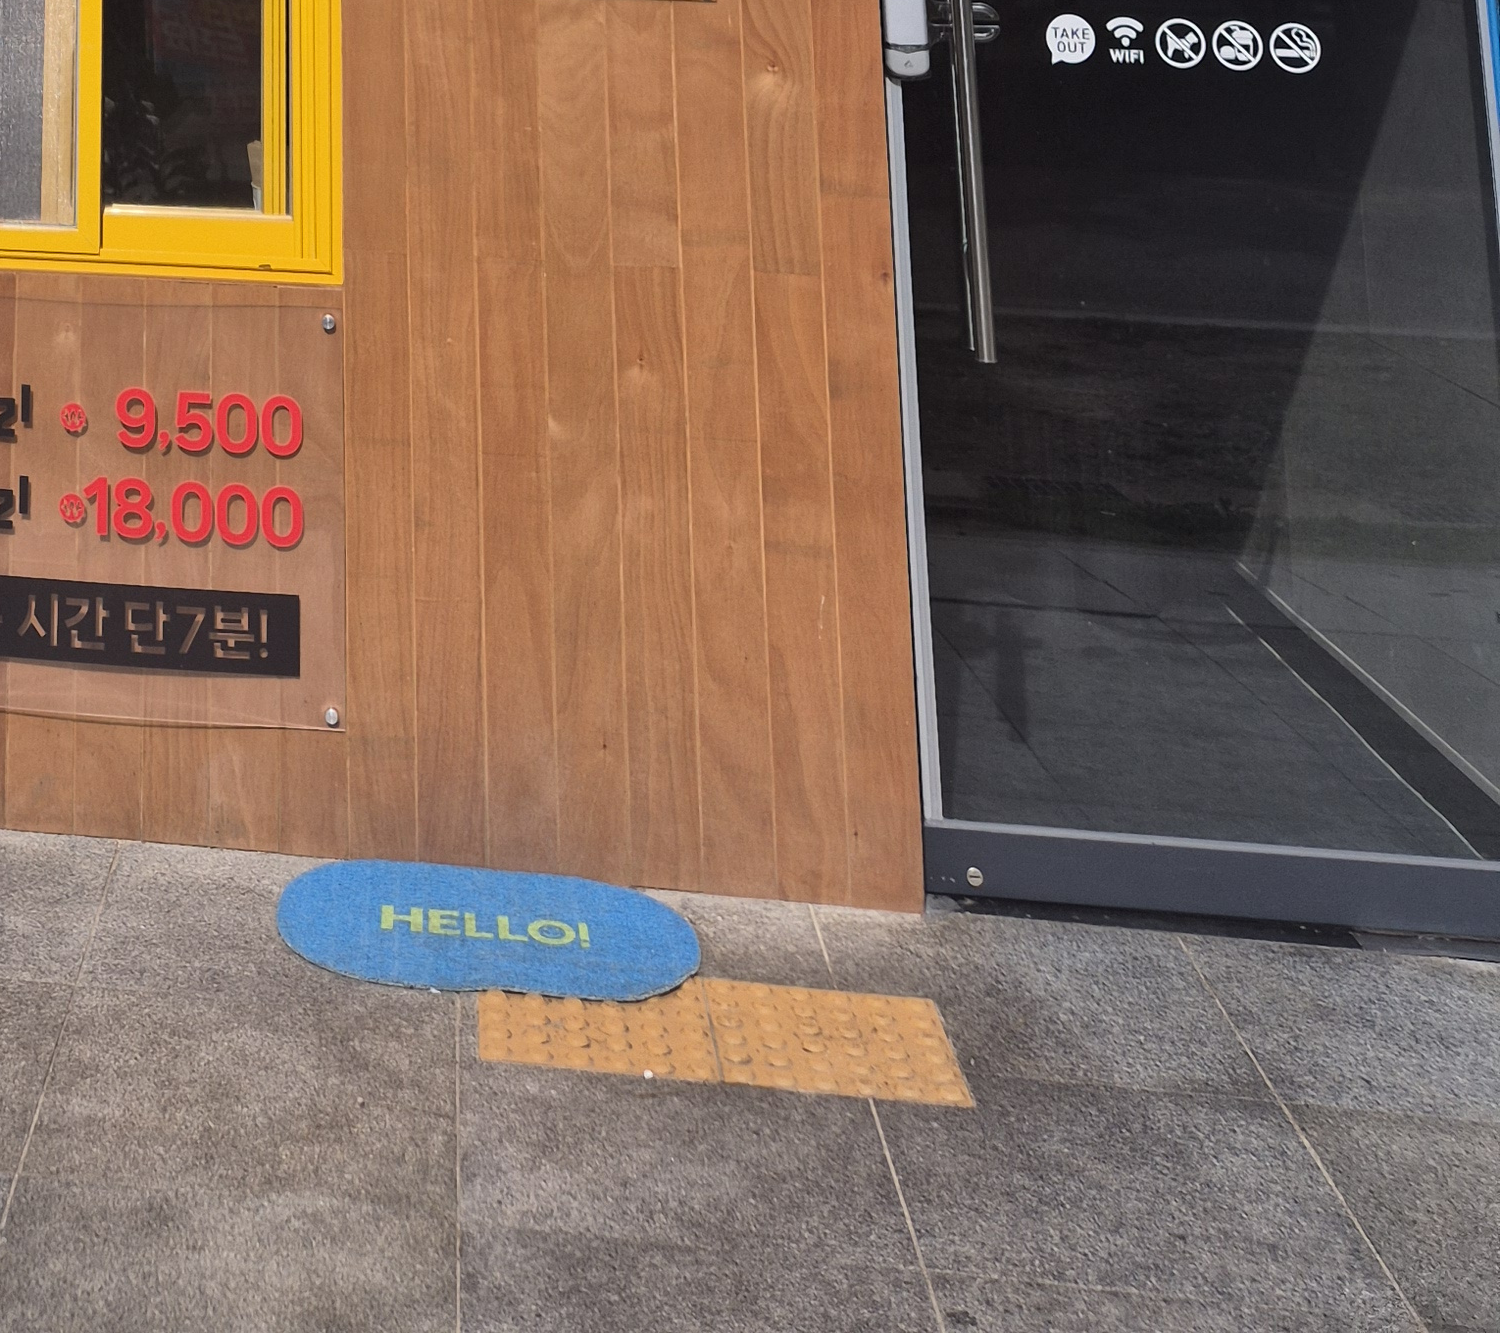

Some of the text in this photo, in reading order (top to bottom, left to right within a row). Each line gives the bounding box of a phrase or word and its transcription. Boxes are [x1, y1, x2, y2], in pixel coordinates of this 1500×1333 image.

[1052, 27, 1090, 40] TAKE
[1057, 41, 1086, 54] OUT
[17, 592, 110, 651] 시간
[380, 904, 591, 949] HELLO!
